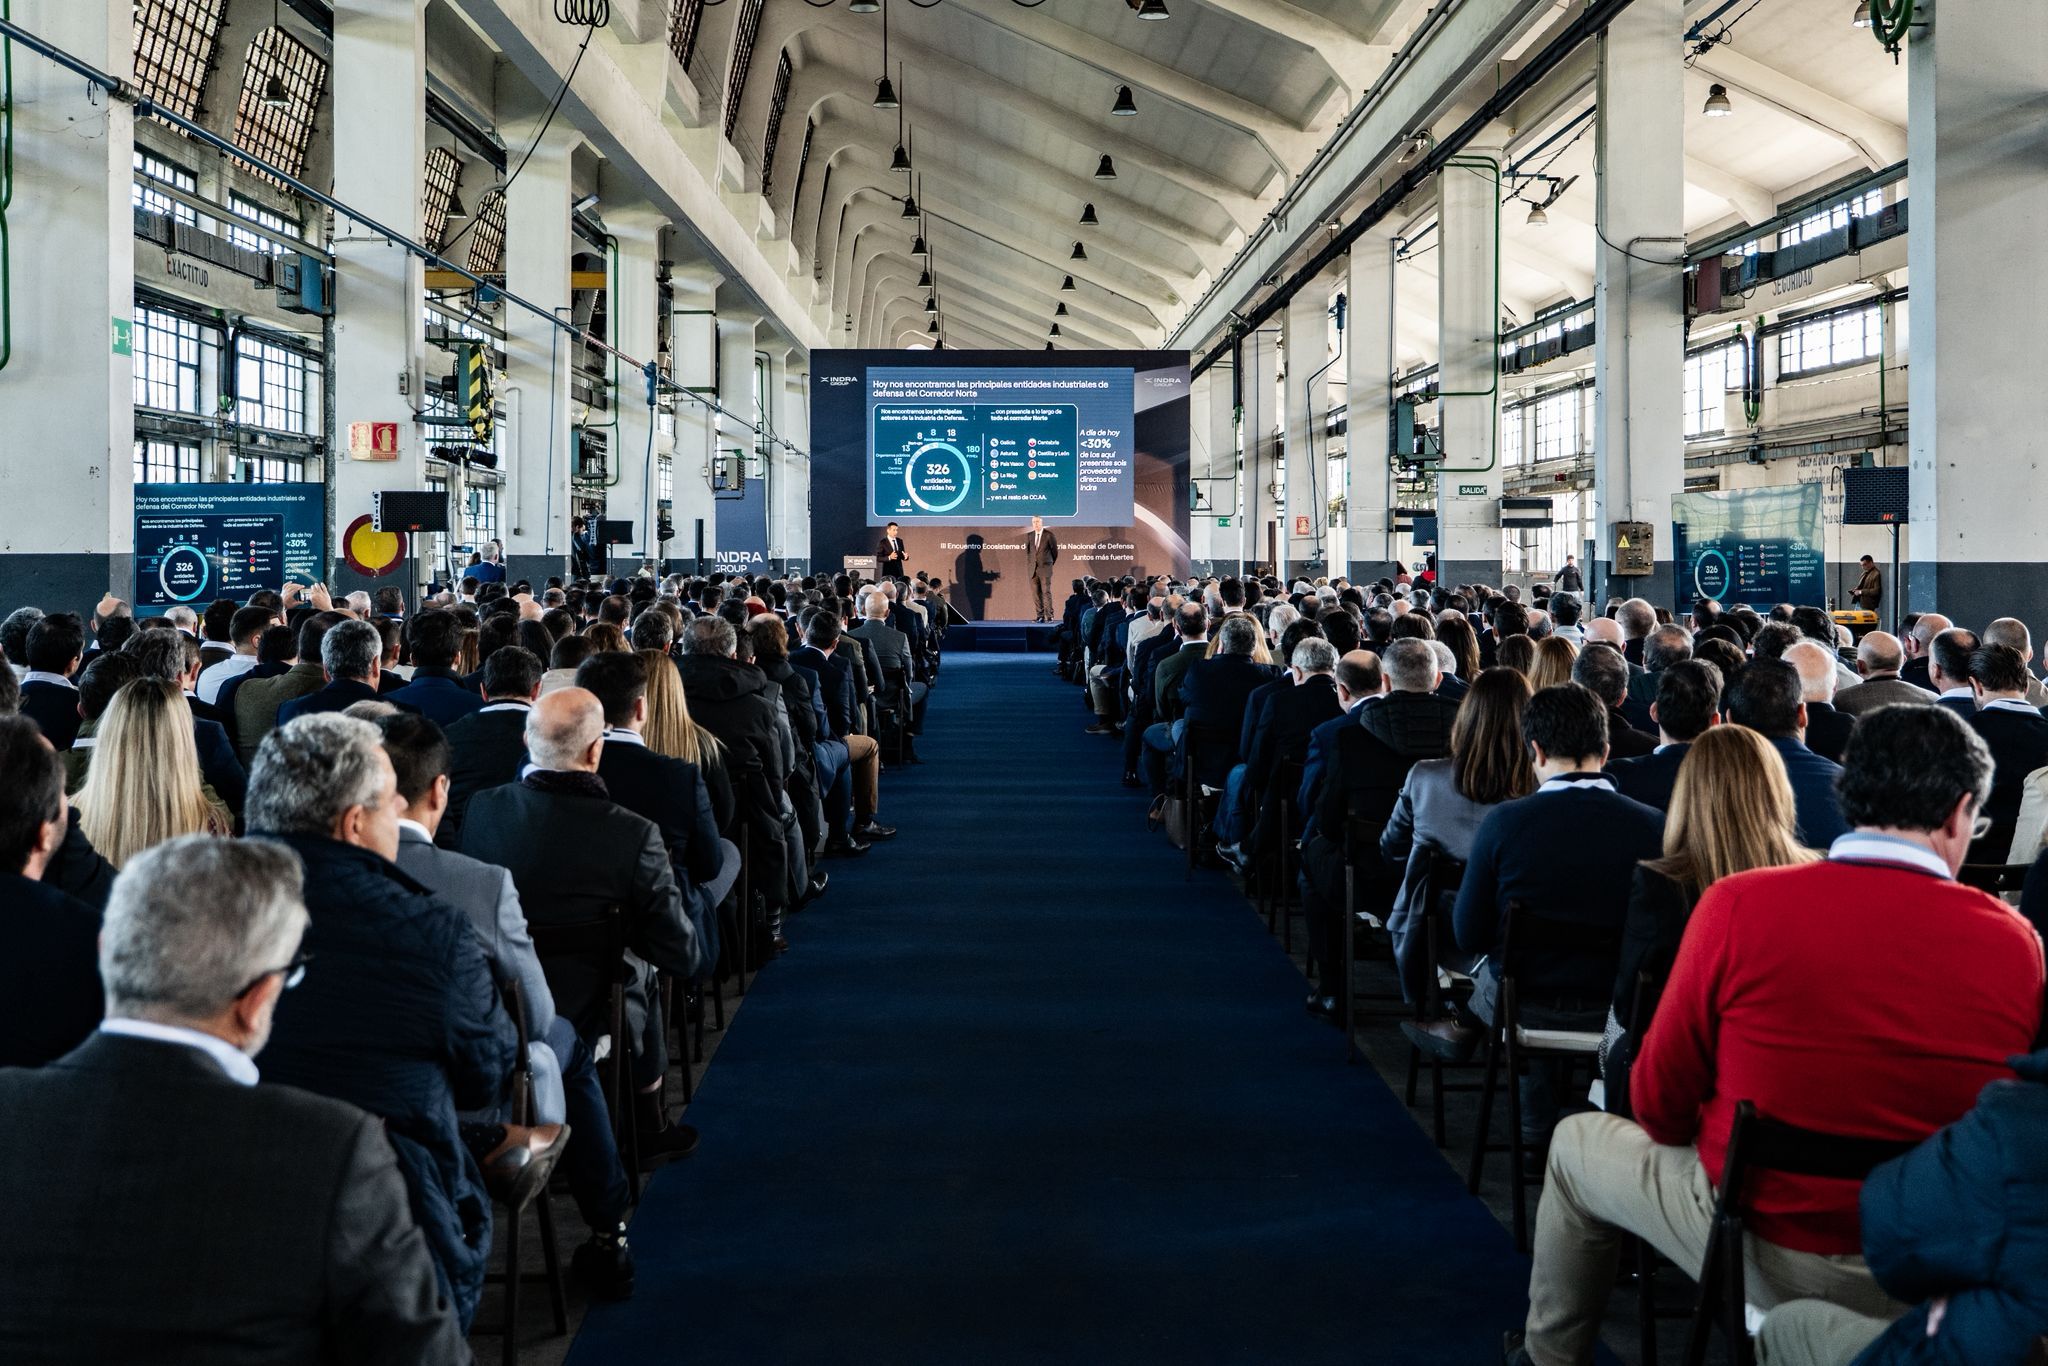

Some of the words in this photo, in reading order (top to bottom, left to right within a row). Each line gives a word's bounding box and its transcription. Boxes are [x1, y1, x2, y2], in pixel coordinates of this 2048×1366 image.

[167, 254, 208, 287] EXACTITUD
[1772, 268, 1813, 296] SEGURIDAD
[873, 381, 887, 389] Hoy
[970, 381, 1012, 389] principales
[1080, 439, 1111, 449] <30%
[927, 464, 950, 474] 326
[717, 552, 763, 562] NDRA
[176, 563, 193, 571] 326
[1706, 566, 1718, 574] 326
